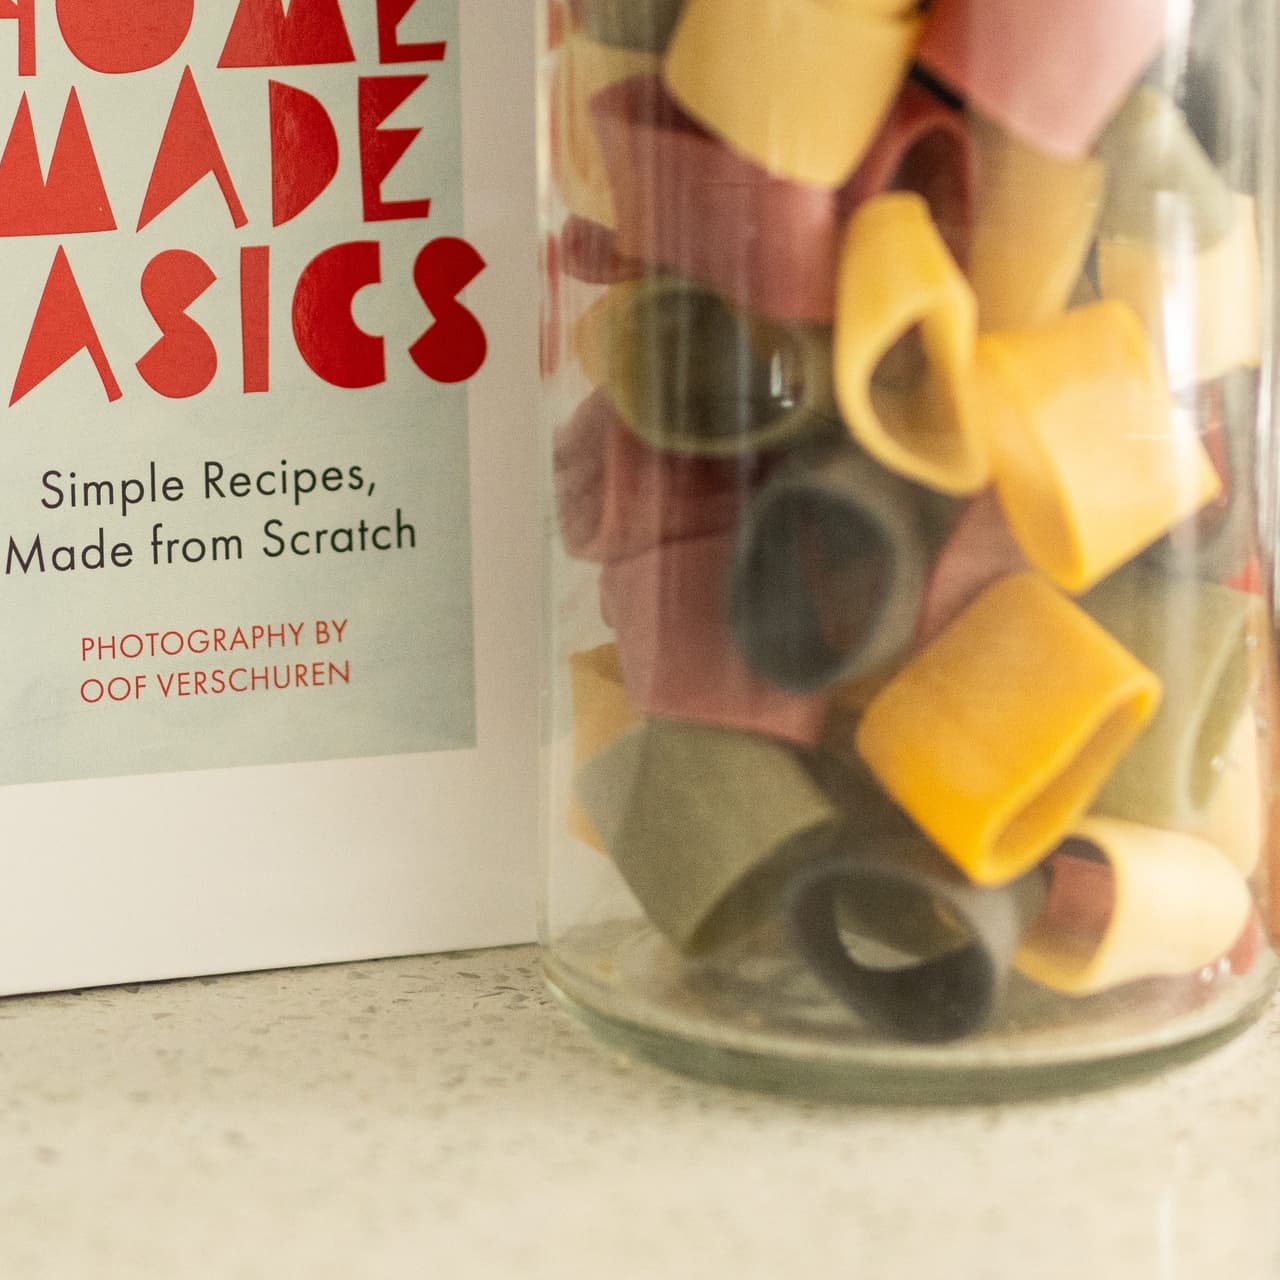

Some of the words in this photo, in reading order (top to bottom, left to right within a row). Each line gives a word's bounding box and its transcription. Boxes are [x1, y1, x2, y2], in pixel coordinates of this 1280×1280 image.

[40, 461, 185, 517] Simple
[204, 459, 377, 506] Recipes,
[5, 527, 134, 575] Made
[150, 522, 243, 566] from
[262, 508, 418, 559] Scratch
[81, 622, 305, 662] PHOTOGRAPHY
[315, 619, 348, 645] BY
[80, 674, 148, 704] OOF
[157, 659, 351, 699] VERSCHUREN
